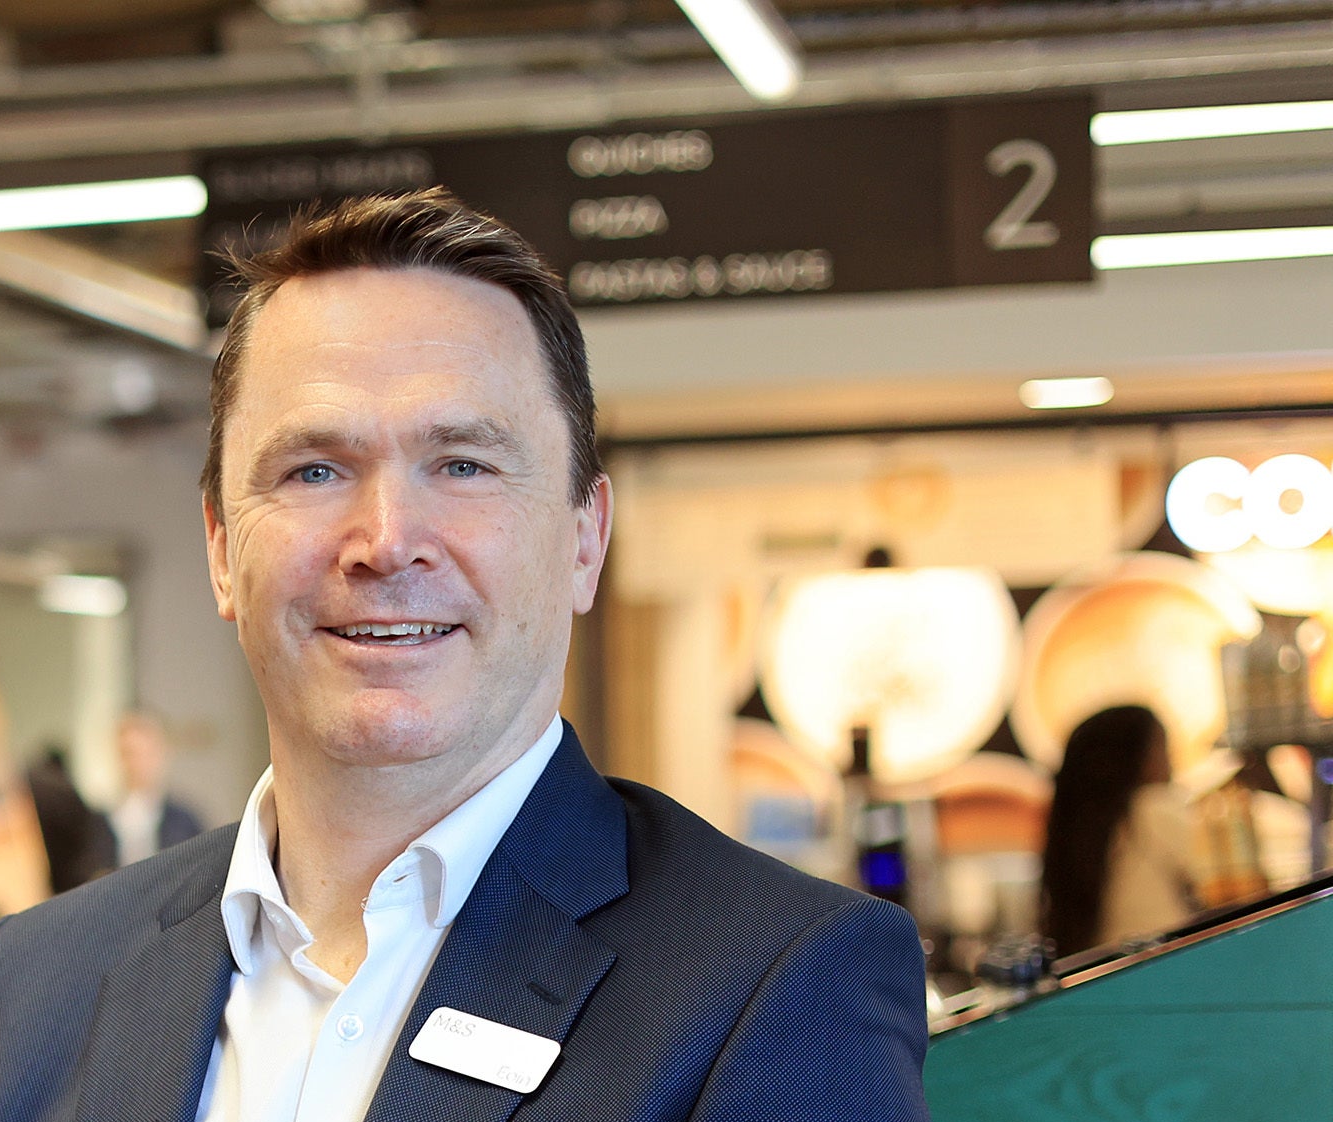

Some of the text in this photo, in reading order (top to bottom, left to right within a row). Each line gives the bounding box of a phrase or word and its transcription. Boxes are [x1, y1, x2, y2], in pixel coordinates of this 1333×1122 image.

[983, 138, 1060, 250] 2
[569, 195, 669, 239] PIZZA
[432, 1013, 477, 1038] M&S
